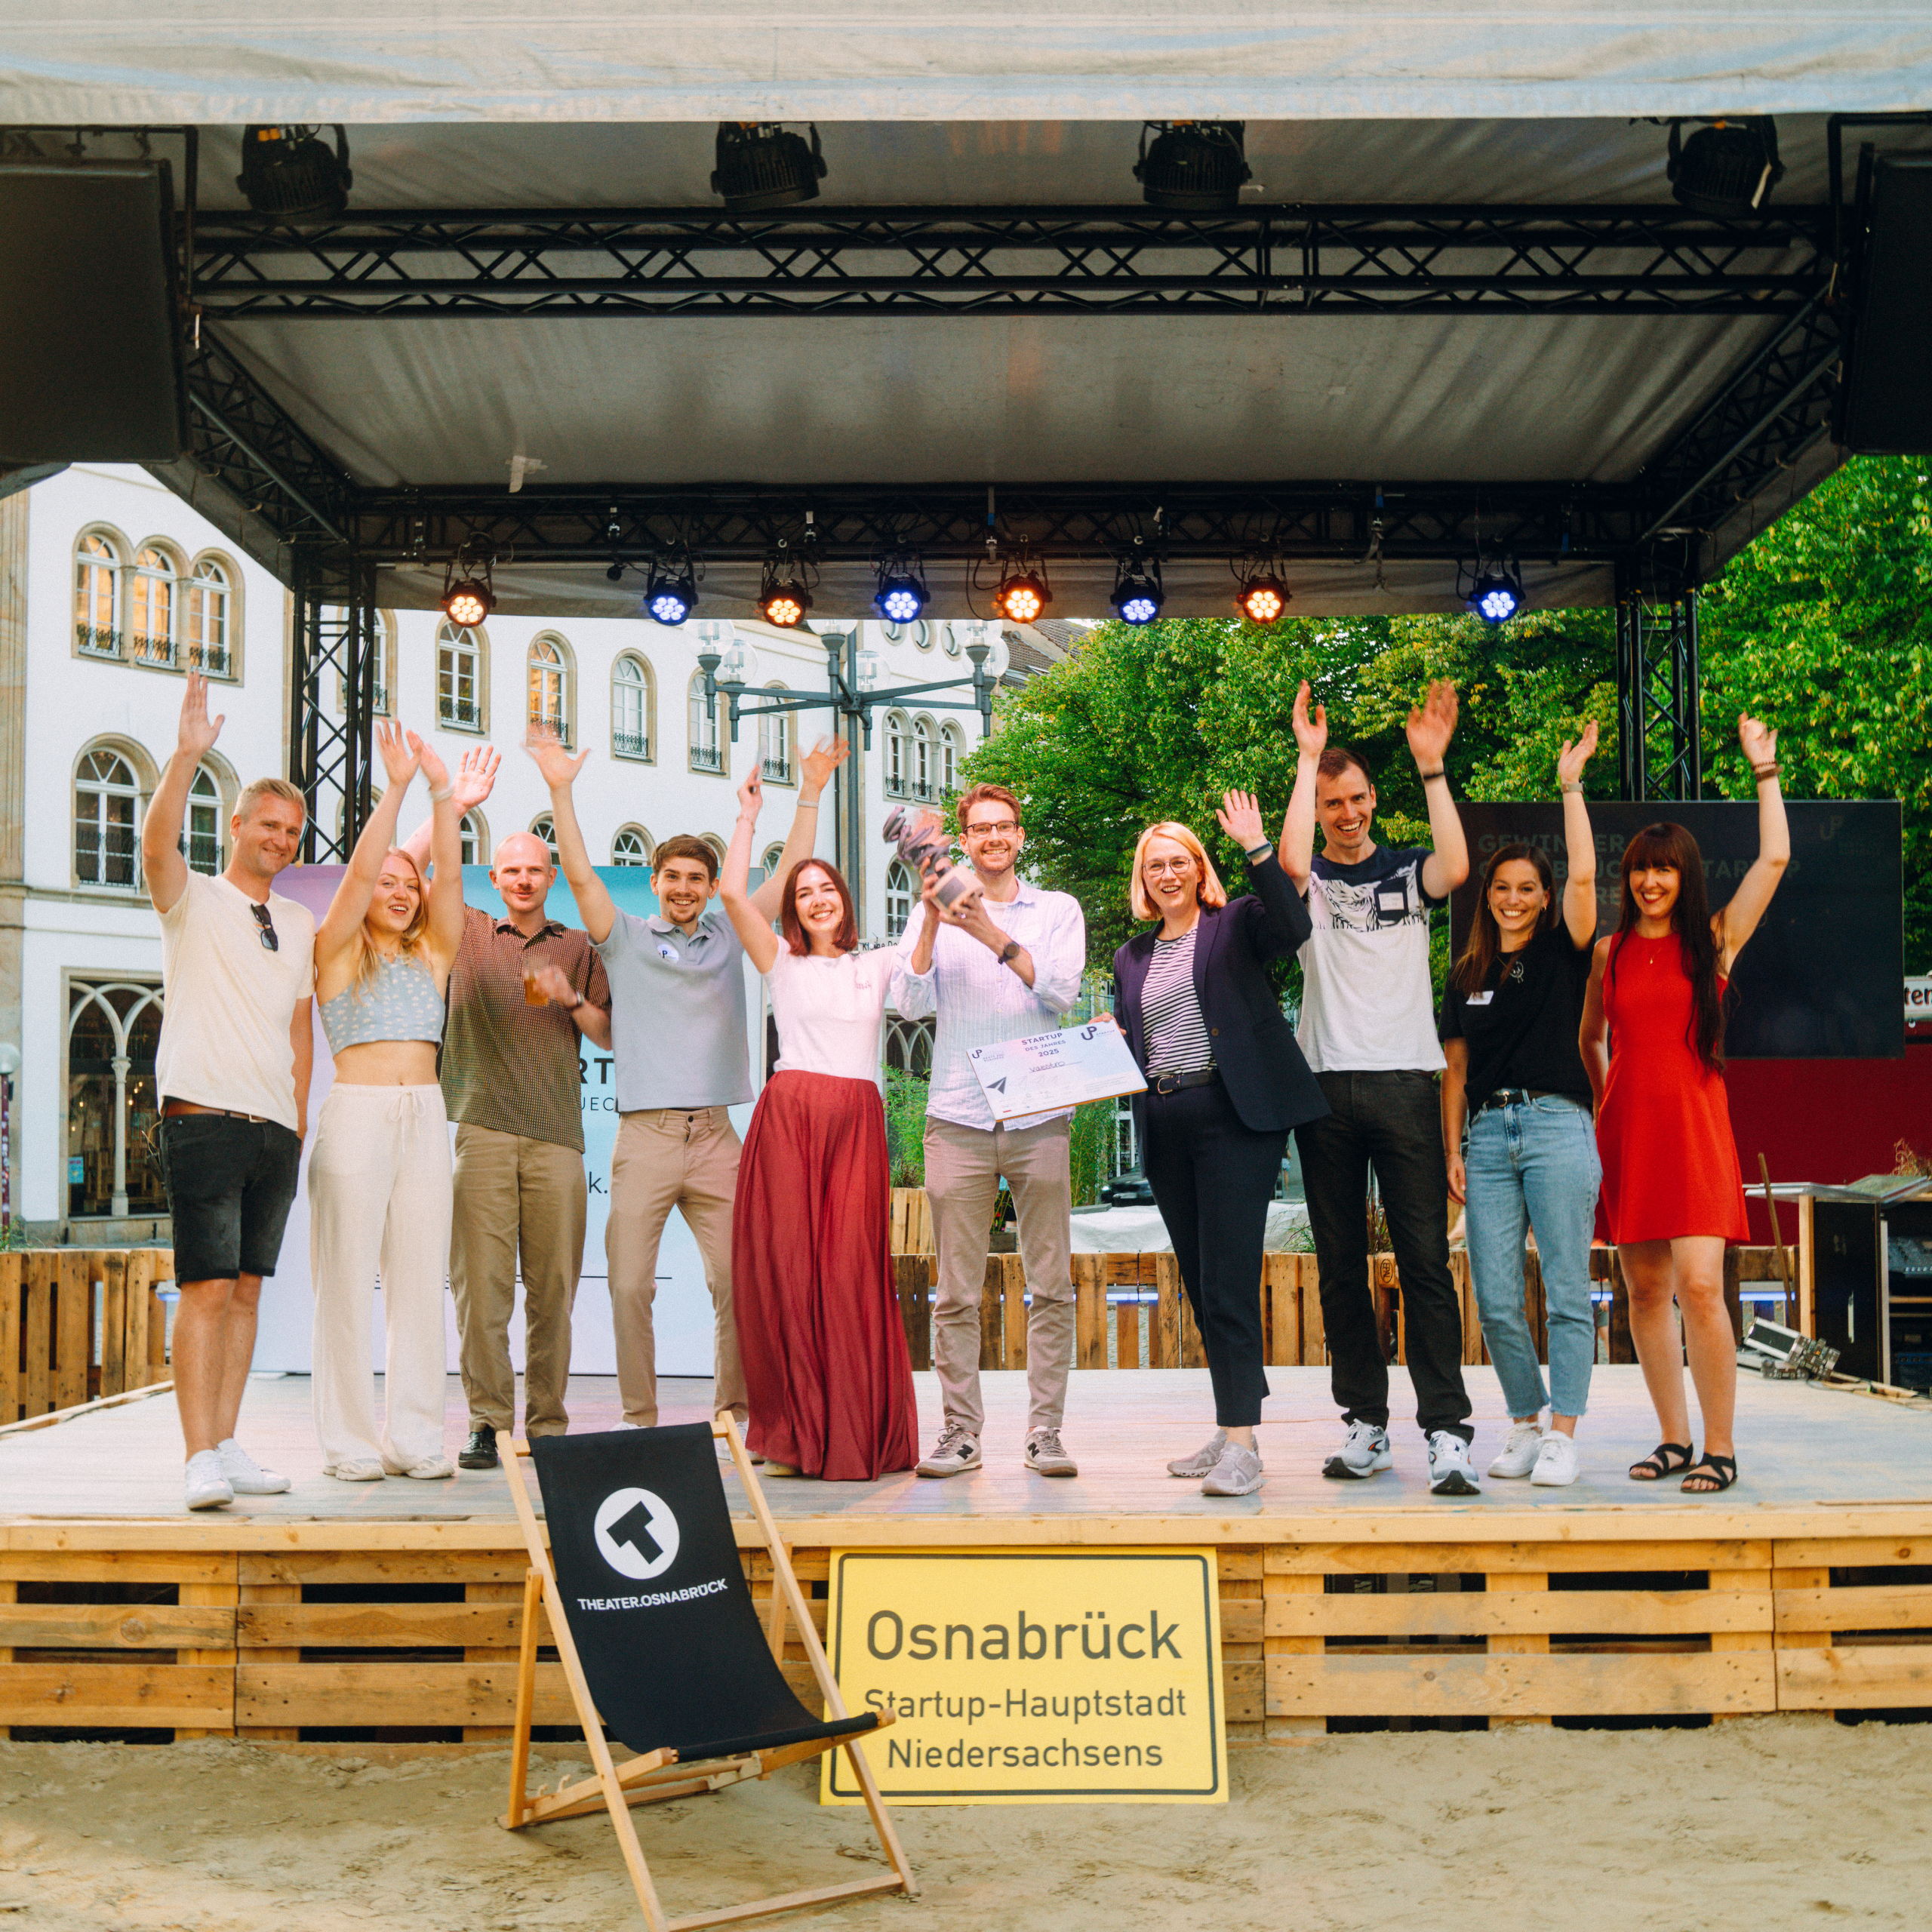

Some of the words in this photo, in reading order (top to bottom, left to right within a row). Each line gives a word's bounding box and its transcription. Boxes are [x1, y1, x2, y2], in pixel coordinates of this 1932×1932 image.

[1021, 1032, 1063, 1045] STARTUP
[1041, 1040, 1066, 1049] JAHRES
[1038, 1048, 1060, 1057] 2025
[867, 1610, 1182, 1660] Osnabrück
[864, 1688, 1186, 1725] Startup-Hauptstadt
[888, 1738, 1163, 1768] Niedersachsens
